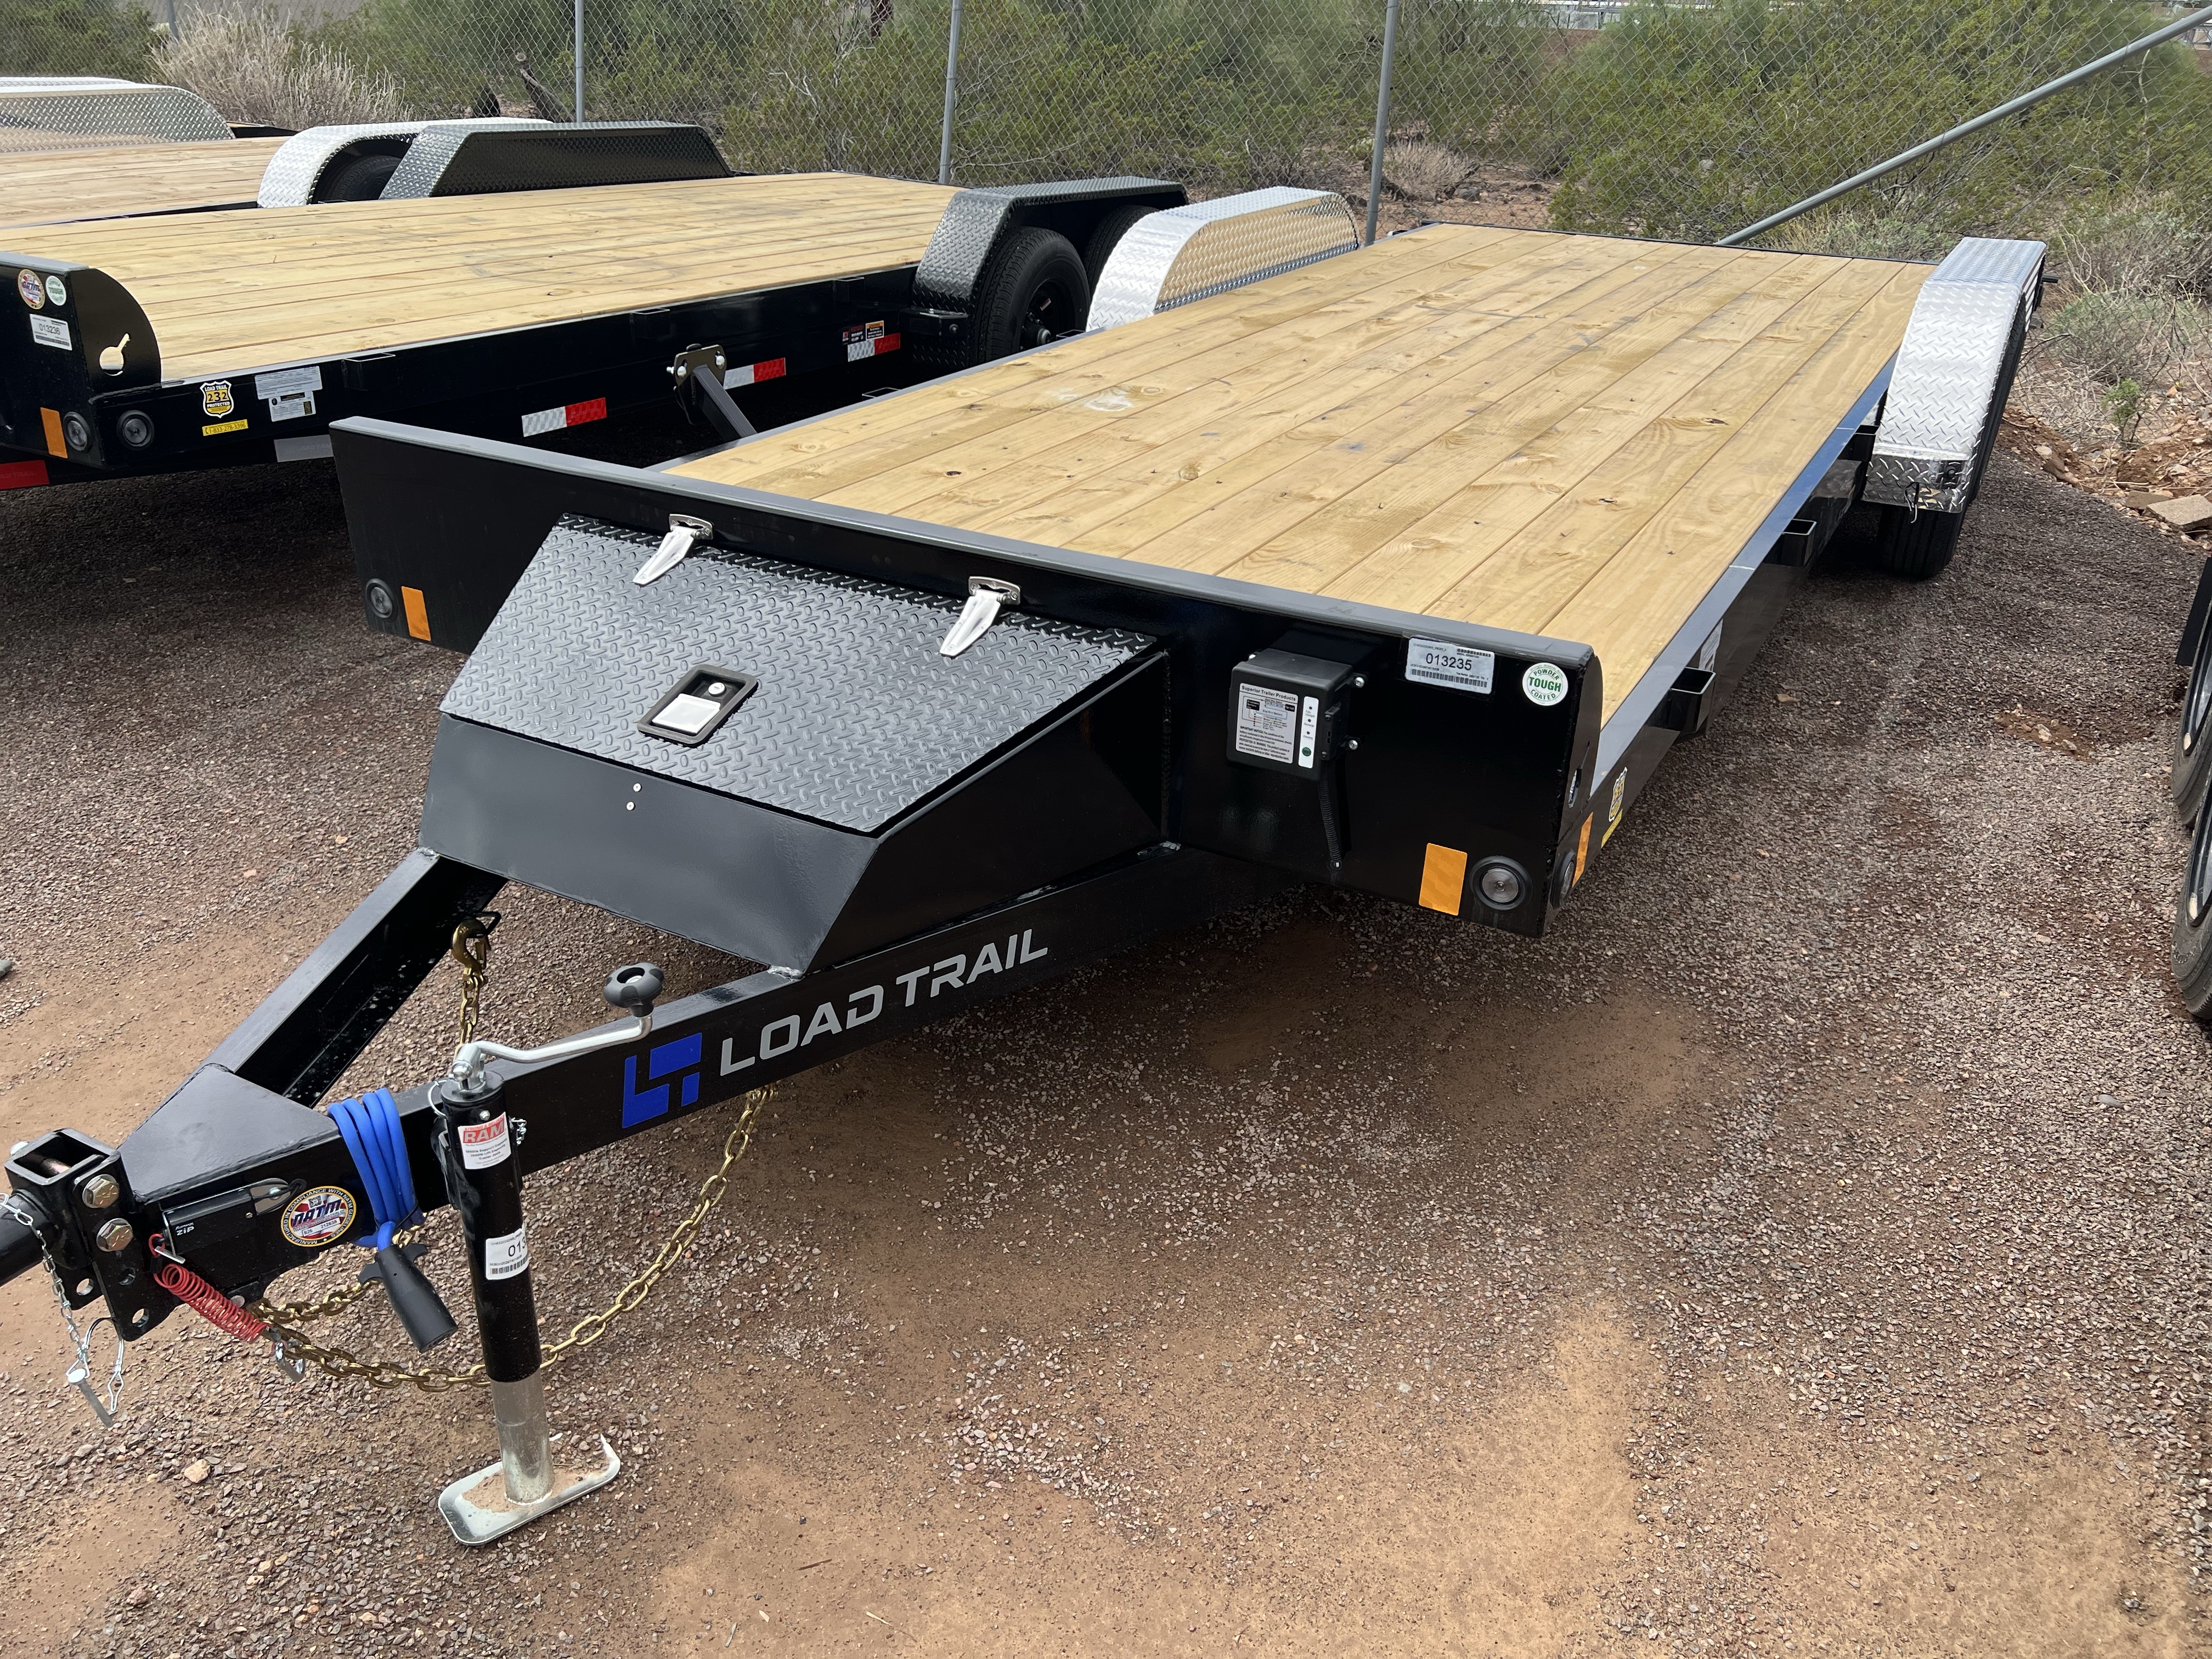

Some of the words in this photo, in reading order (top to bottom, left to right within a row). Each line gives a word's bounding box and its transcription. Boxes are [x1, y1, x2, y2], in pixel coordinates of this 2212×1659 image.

[207, 392, 228, 402] 232
[1426, 653, 1472, 671] 013235
[1533, 669, 1560, 680] POWDER
[1529, 676, 1562, 692] TOUGH
[1242, 686, 1261, 694] Superior
[1276, 693, 1296, 701] Products
[1531, 689, 1556, 700] COATED
[720, 984, 885, 1076] LOAD
[896, 928, 1049, 1008] TRAIL
[464, 1120, 505, 1143] RAM
[288, 1188, 326, 1211] COMPLIANCE
[342, 1194, 353, 1209] NATM
[283, 1219, 318, 1245] MANUFACTURED
[331, 1209, 353, 1238] GUIDELINES
